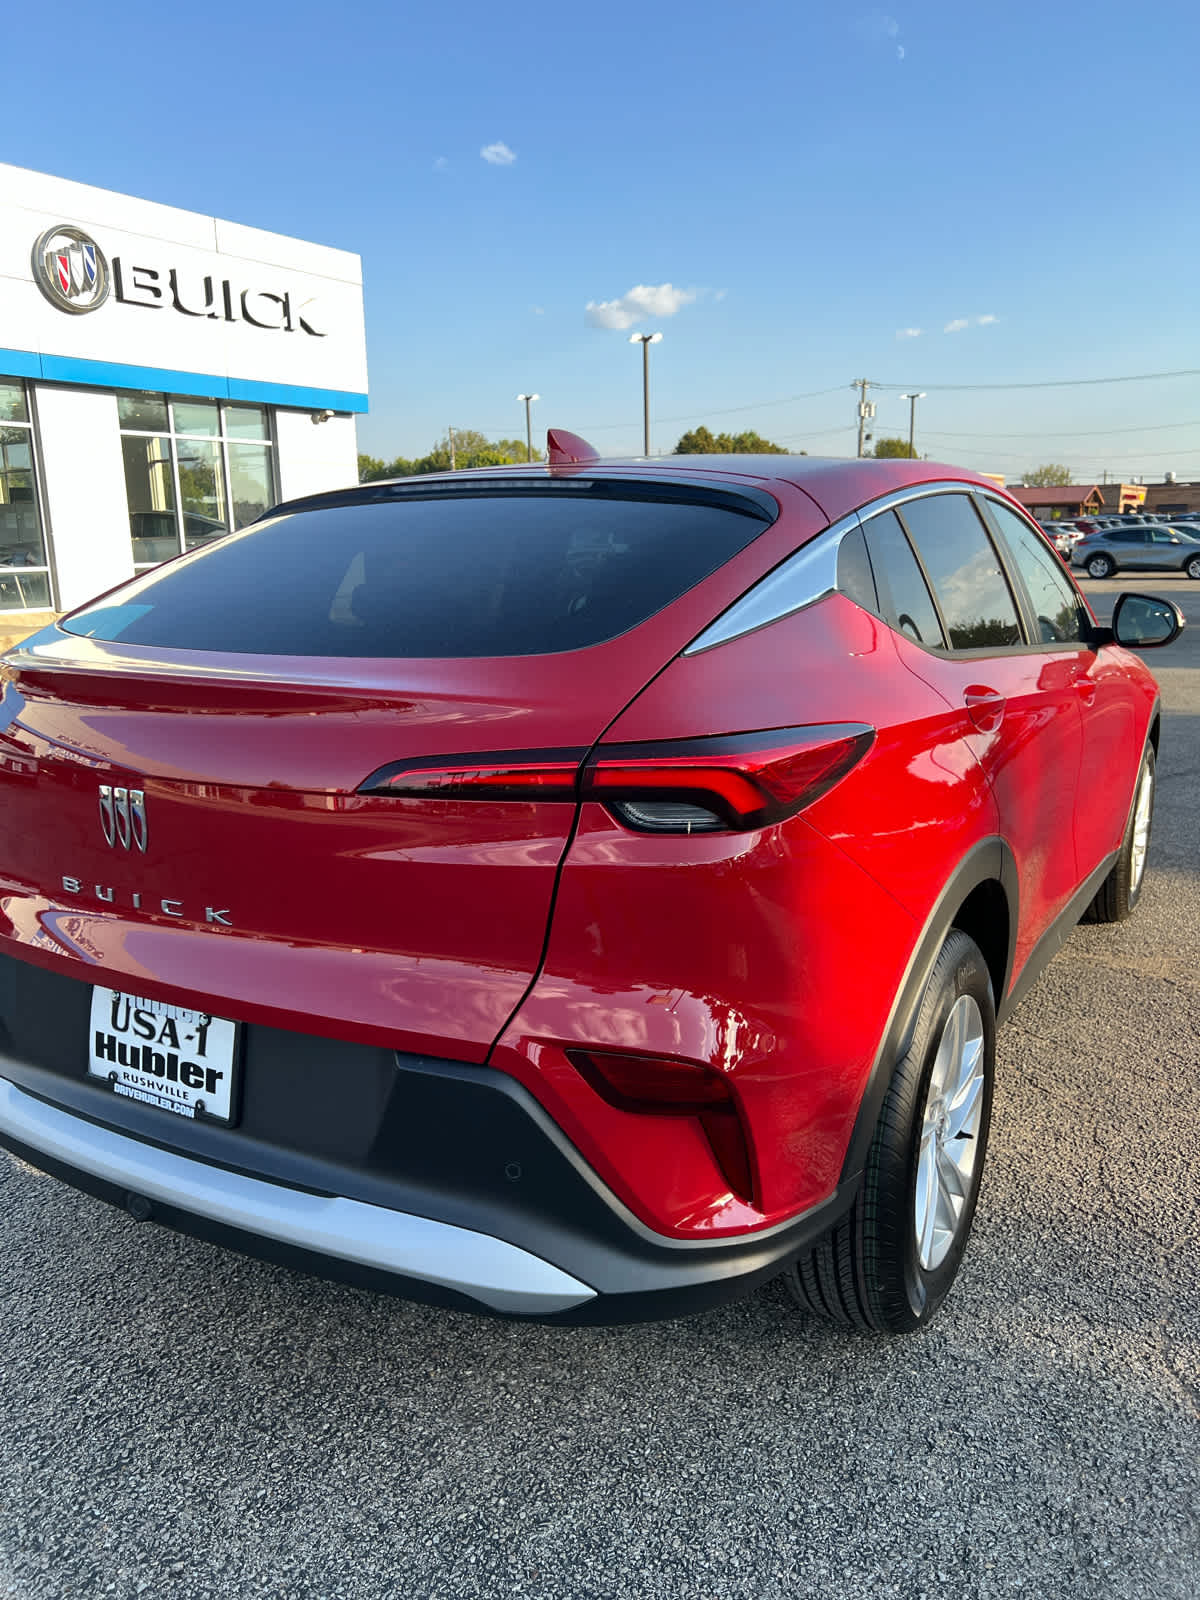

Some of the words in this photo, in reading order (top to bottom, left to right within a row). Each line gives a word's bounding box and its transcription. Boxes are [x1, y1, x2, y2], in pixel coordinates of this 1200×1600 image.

[111, 256, 328, 337] BUICK
[62, 876, 233, 926] BUICK
[111, 997, 208, 1057] USA-1
[95, 1030, 224, 1095] Hubler
[122, 1071, 190, 1101] RUSHVILLE
[113, 1082, 195, 1119] DRIVEHUBLER.COM
